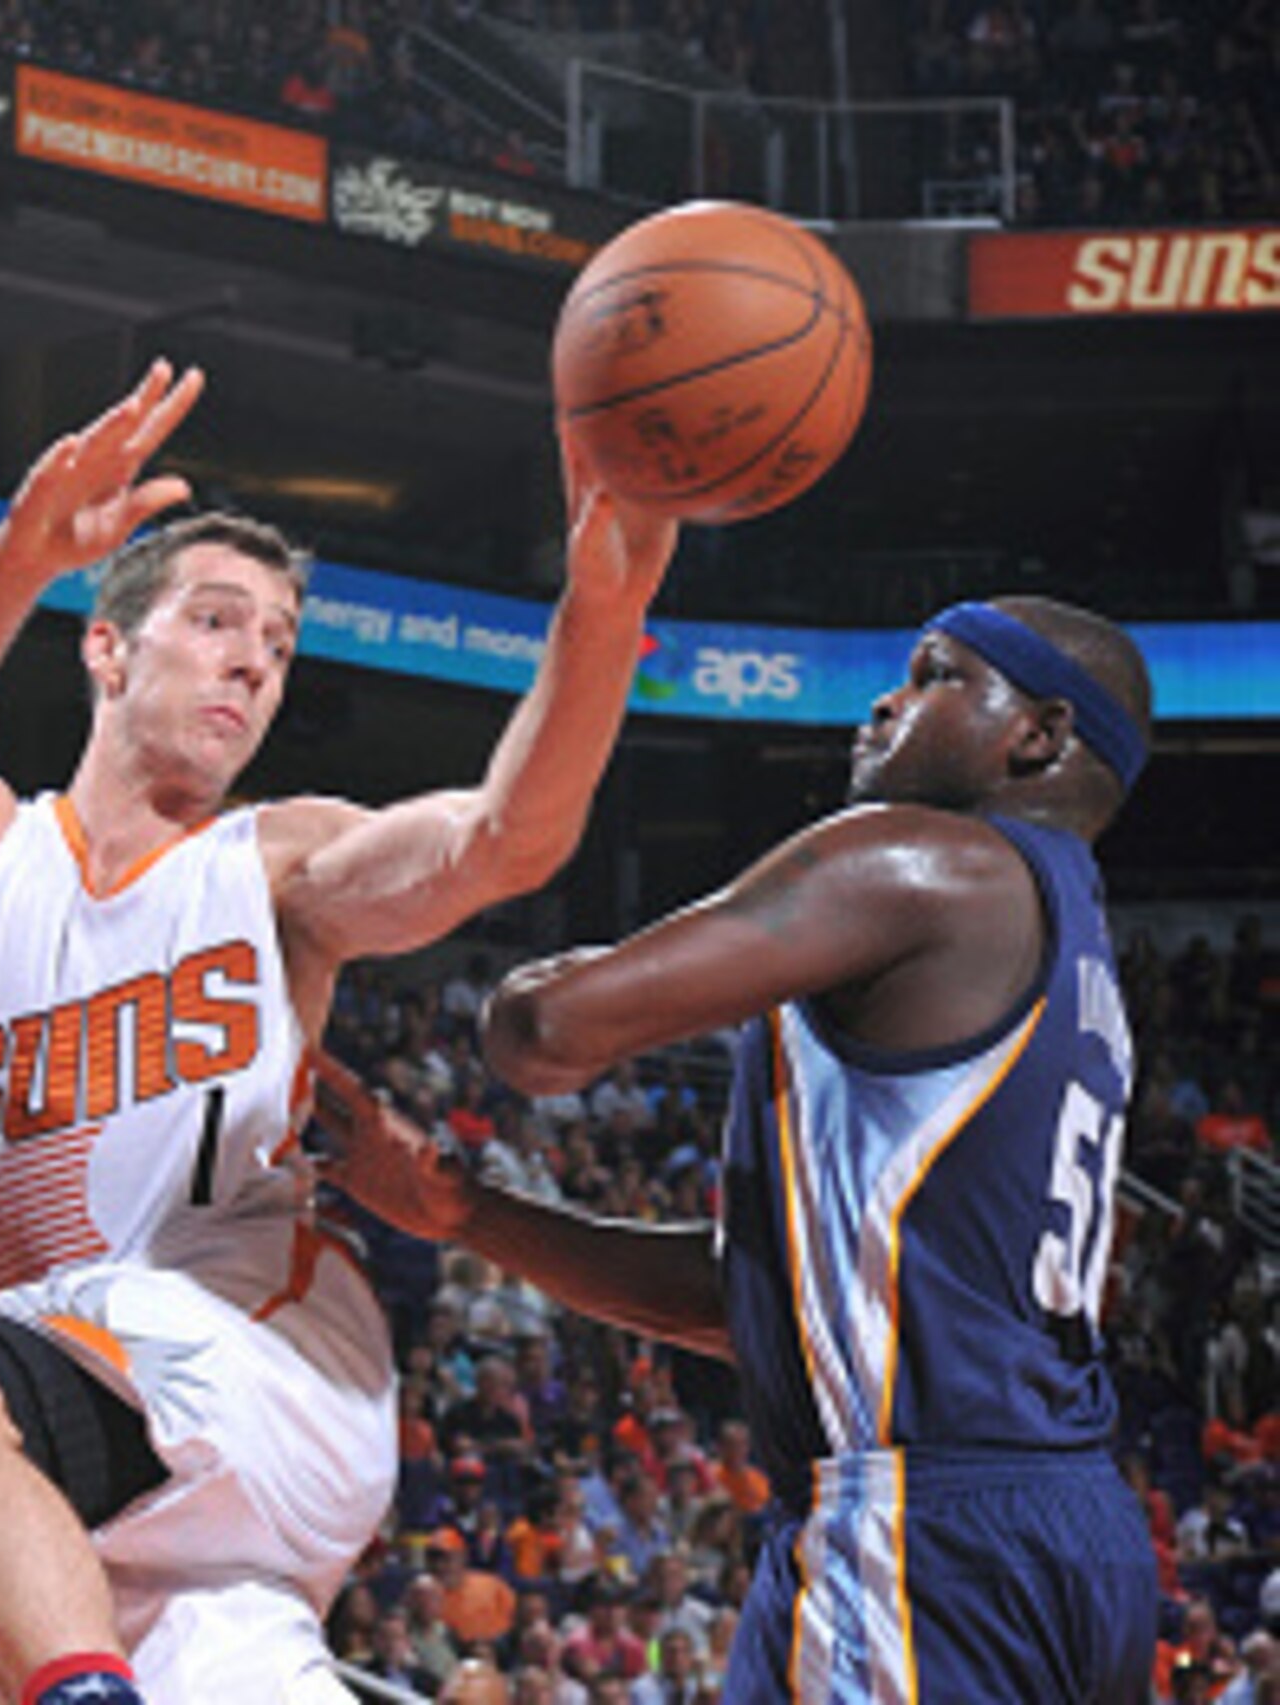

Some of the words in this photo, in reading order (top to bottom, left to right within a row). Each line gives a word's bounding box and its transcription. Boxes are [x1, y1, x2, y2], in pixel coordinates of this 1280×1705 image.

[22, 110, 322, 206] PHOENIXMERCURY.COM
[304, 595, 393, 644] nergy
[399, 612, 458, 650] and
[464, 624, 552, 664] mone
[693, 647, 801, 707] aps
[190, 1087, 225, 1206] 1
